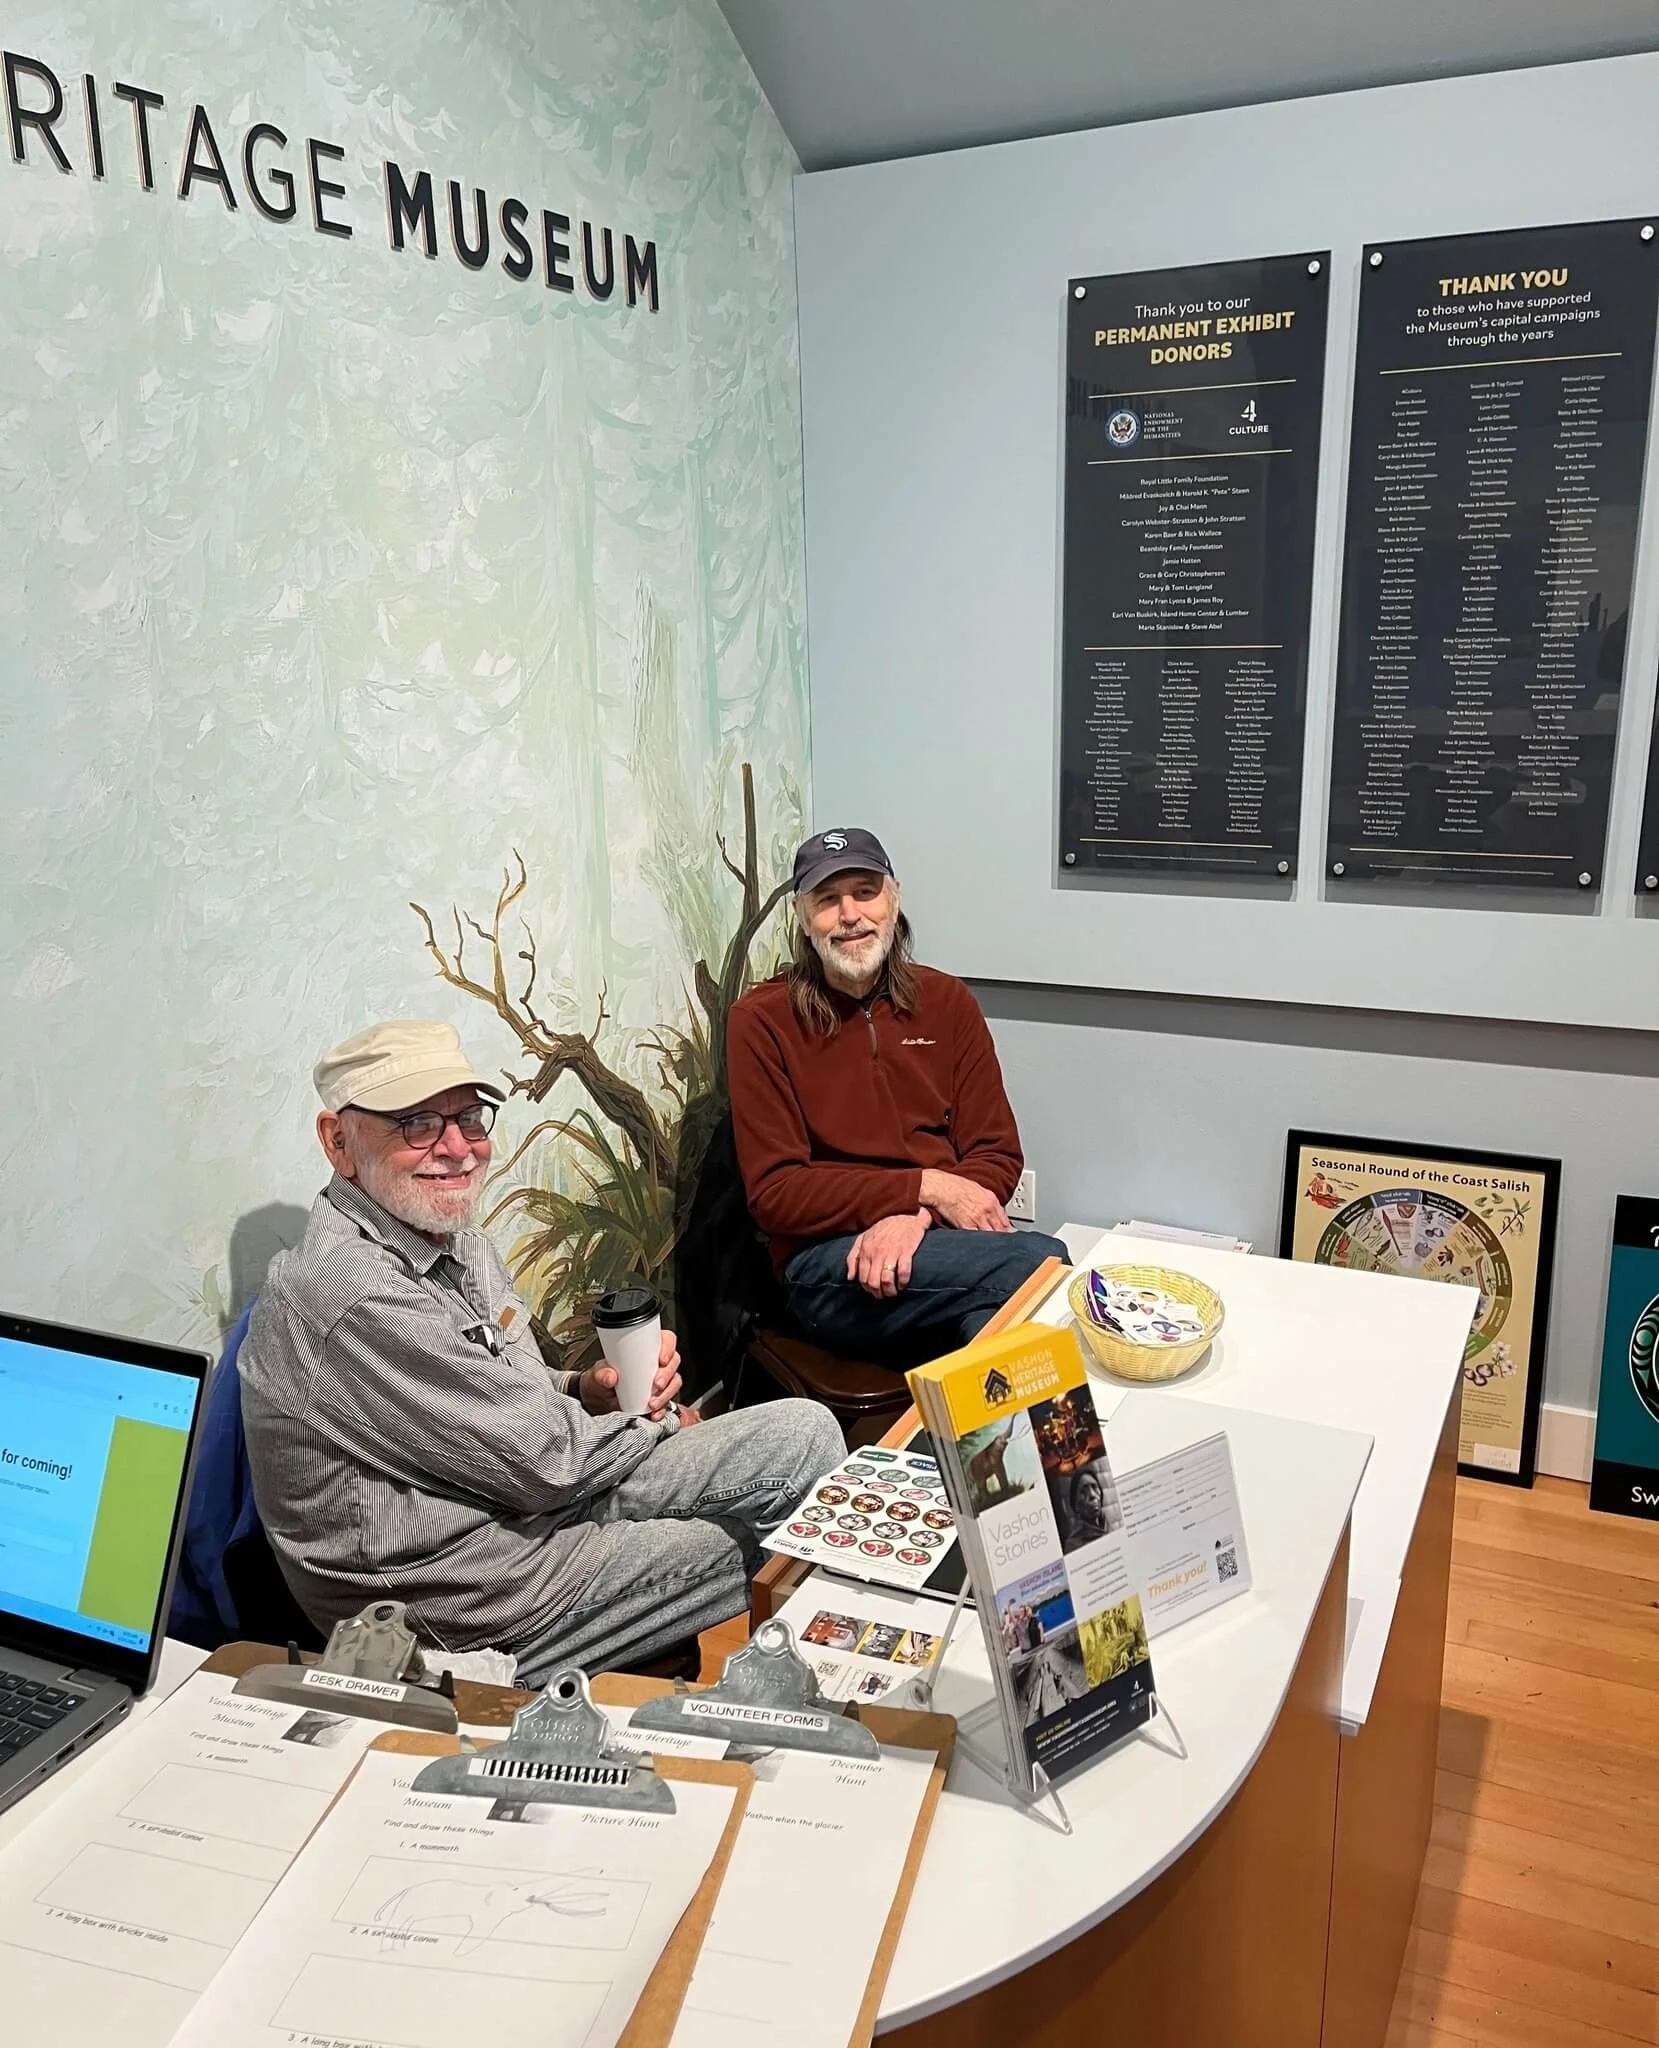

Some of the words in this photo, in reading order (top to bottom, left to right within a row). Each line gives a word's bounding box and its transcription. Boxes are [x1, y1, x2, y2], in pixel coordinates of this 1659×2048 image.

[0, 50, 353, 238] RITAGE
[383, 160, 660, 314] MUSEUM
[1439, 272, 1516, 297] THANK
[1520, 268, 1568, 289] YOU
[1135, 302, 1176, 320] Thank
[1179, 302, 1204, 318] you
[1207, 299, 1222, 312] to
[1225, 298, 1251, 310] our
[1417, 307, 1430, 318] to
[1432, 303, 1465, 316] those
[1468, 300, 1493, 313] who
[1496, 298, 1524, 311] have
[1527, 291, 1591, 309] supported
[1094, 319, 1212, 346] PERMANENT
[1216, 311, 1295, 336] EXHIBIT
[1406, 323, 1425, 335] the
[1428, 317, 1488, 333] Museum's
[1491, 313, 1531, 330] capital
[1534, 309, 1601, 328] campaigns
[1447, 333, 1496, 348] through
[1498, 331, 1519, 343] the
[1521, 330, 1554, 345] years
[1150, 342, 1233, 365] DONORS
[1143, 411, 1175, 419] NATIONAL
[1240, 399, 1257, 423] 4
[1143, 418, 1184, 426] ENDOWMENT
[1228, 424, 1269, 435] CULTURE
[1143, 432, 1181, 440] HUMANITIES
[1174, 477, 1193, 485] Family
[1194, 475, 1229, 483] Foundation
[1204, 515, 1219, 525] John
[1169, 544, 1189, 553] Family
[1189, 543, 1224, 551] Foundation
[1148, 585, 1163, 593] Mary
[1138, 598, 1154, 606] Mary
[1225, 609, 1249, 617] Lumber
[1311, 1157, 1366, 1174] Seasonal
[1368, 1163, 1409, 1179] Round
[1412, 1170, 1426, 1180] of
[1428, 1171, 1449, 1183] the
[1452, 1174, 1489, 1188] Coast
[1491, 1178, 1530, 1193] Salish
[1010, 1347, 1053, 1374] VASHON
[1013, 1360, 1056, 1386] HERITAGE
[1016, 1373, 1060, 1399] MUSEUM
[1, 1448, 20, 1465] for
[21, 1456, 73, 1481] coming!
[988, 1506, 1050, 1544] Vashon
[994, 1530, 1049, 1566] Stories
[1147, 1573, 1182, 1600] Thank
[1184, 1560, 1208, 1582] you!
[309, 1673, 343, 1689] DESK
[345, 1680, 400, 1698] DRAWER
[208, 1695, 243, 1712] Vashon
[244, 1702, 289, 1721] Heritage
[690, 1703, 771, 1721] VOLUNTEER
[774, 1713, 824, 1728] FORMS
[212, 1712, 256, 1729] Museum
[644, 1730, 693, 1749] Heritage
[828, 1758, 886, 1774] December
[833, 1773, 868, 1787] Hunt
[403, 1797, 453, 1811] Museum
[384, 1818, 401, 1828] Find
[403, 1821, 418, 1830] and
[420, 1822, 440, 1832] draw
[581, 1812, 625, 1827] Picture
[627, 1815, 661, 1830] Hunt
[775, 1816, 797, 1825] when
[799, 1818, 813, 1828] the
[815, 1820, 845, 1832] glacier
[419, 1843, 460, 1853] mammoth
[65, 1913, 82, 1925] long
[98, 1921, 117, 1932] with
